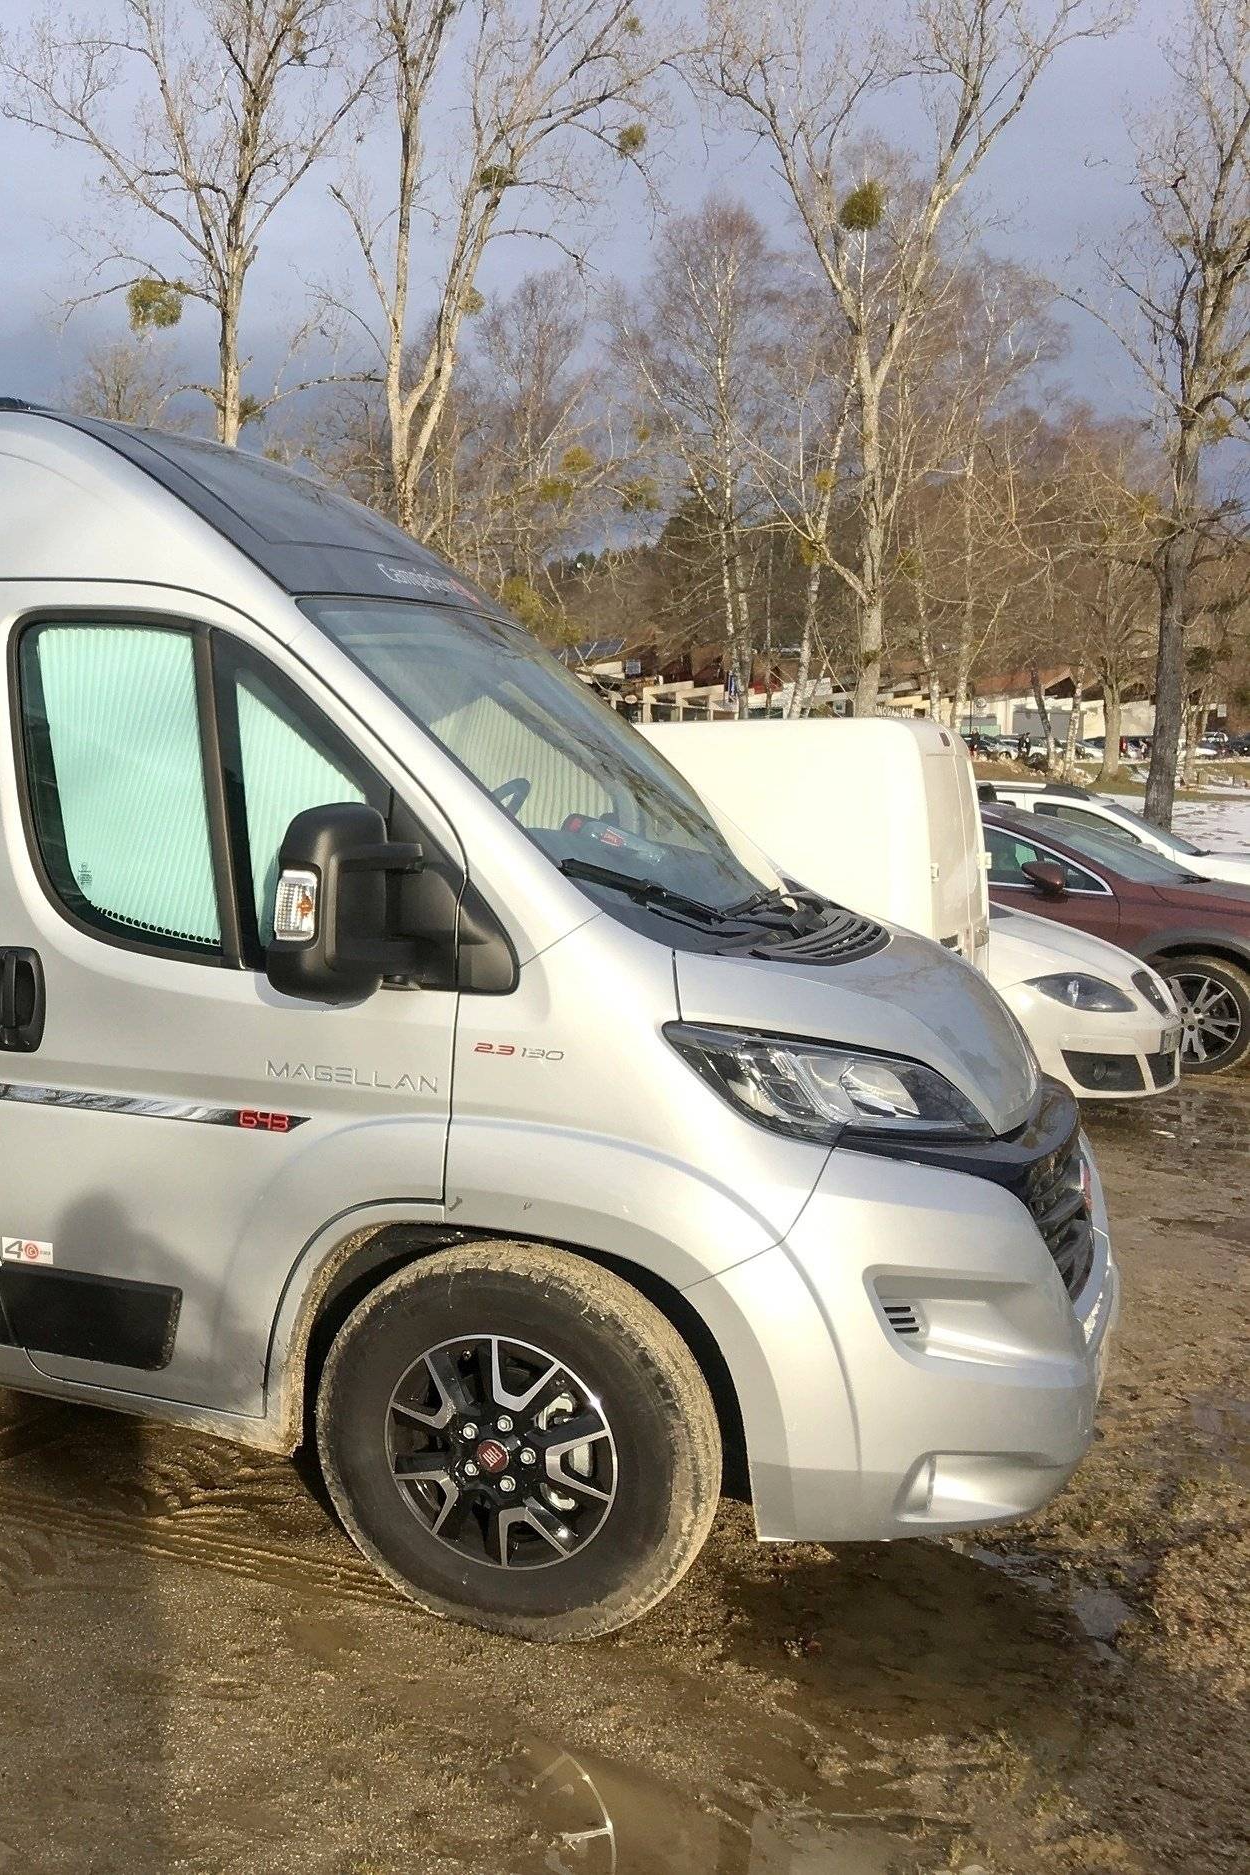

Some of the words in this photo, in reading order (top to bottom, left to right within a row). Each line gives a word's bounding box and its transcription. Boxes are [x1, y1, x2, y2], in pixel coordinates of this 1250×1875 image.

[265, 1059, 438, 1094] MAGELLAN
[239, 1110, 289, 1131] 643
[482, 1446, 503, 1467] FIAT
